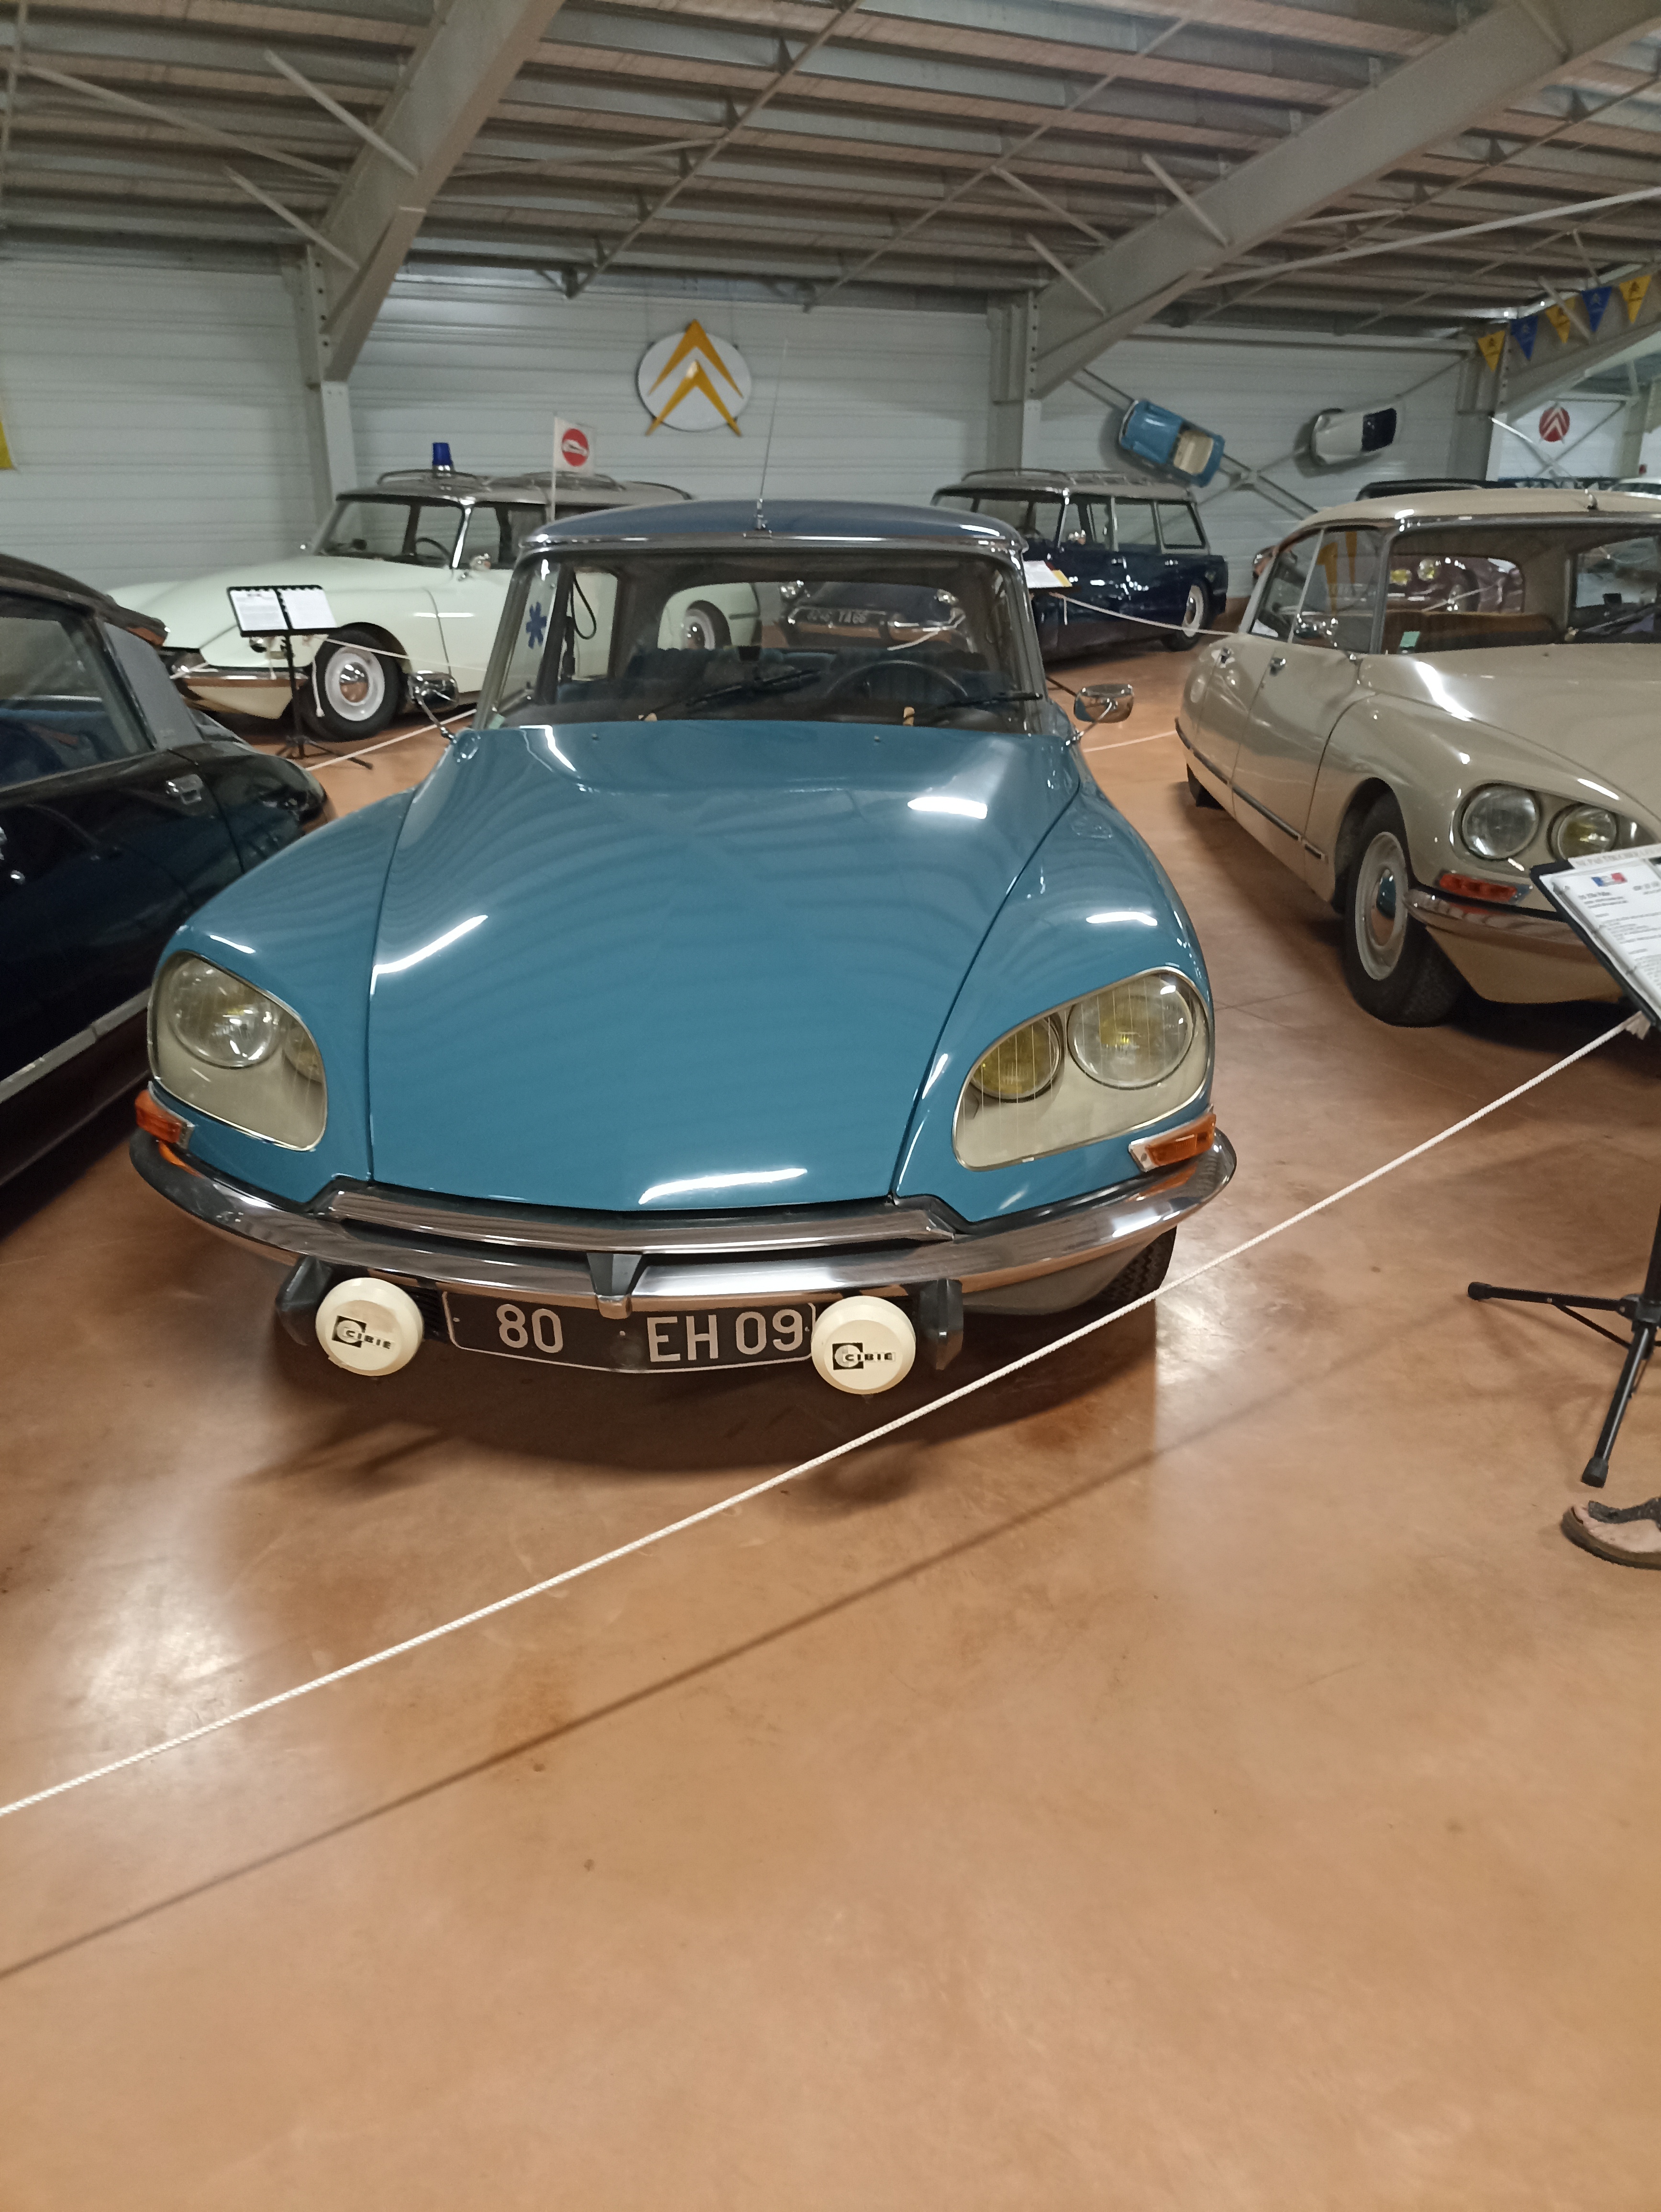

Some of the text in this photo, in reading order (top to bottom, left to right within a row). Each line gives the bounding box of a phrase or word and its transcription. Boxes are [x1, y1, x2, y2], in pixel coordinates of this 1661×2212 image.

[345, 1329, 391, 1349] CIBIE
[496, 1304, 803, 1362] 80 EH 09
[844, 1352, 893, 1362] CIBIE
